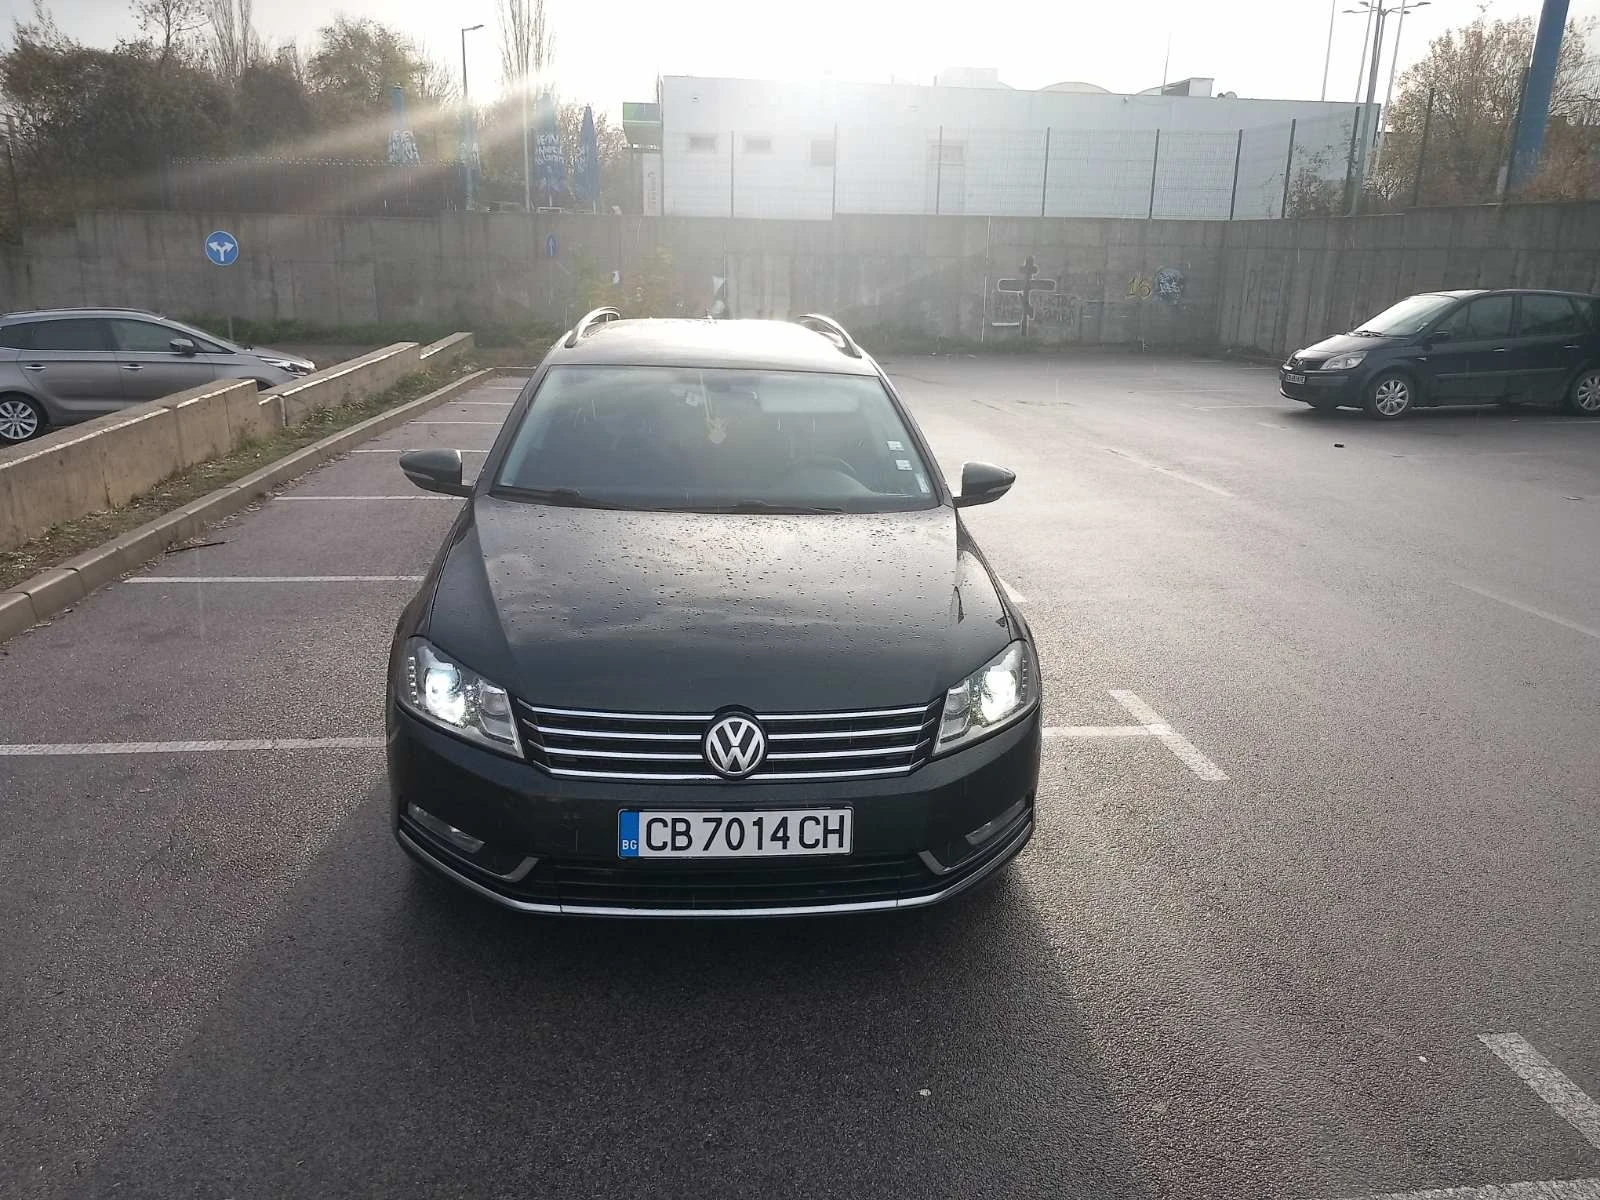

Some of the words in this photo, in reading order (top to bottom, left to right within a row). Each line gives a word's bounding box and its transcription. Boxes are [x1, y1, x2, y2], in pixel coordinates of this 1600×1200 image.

[706, 717, 765, 775] VW
[622, 839, 638, 851] BG
[646, 817, 693, 852] CB
[702, 816, 790, 852] 7014
[798, 814, 845, 850] CH
